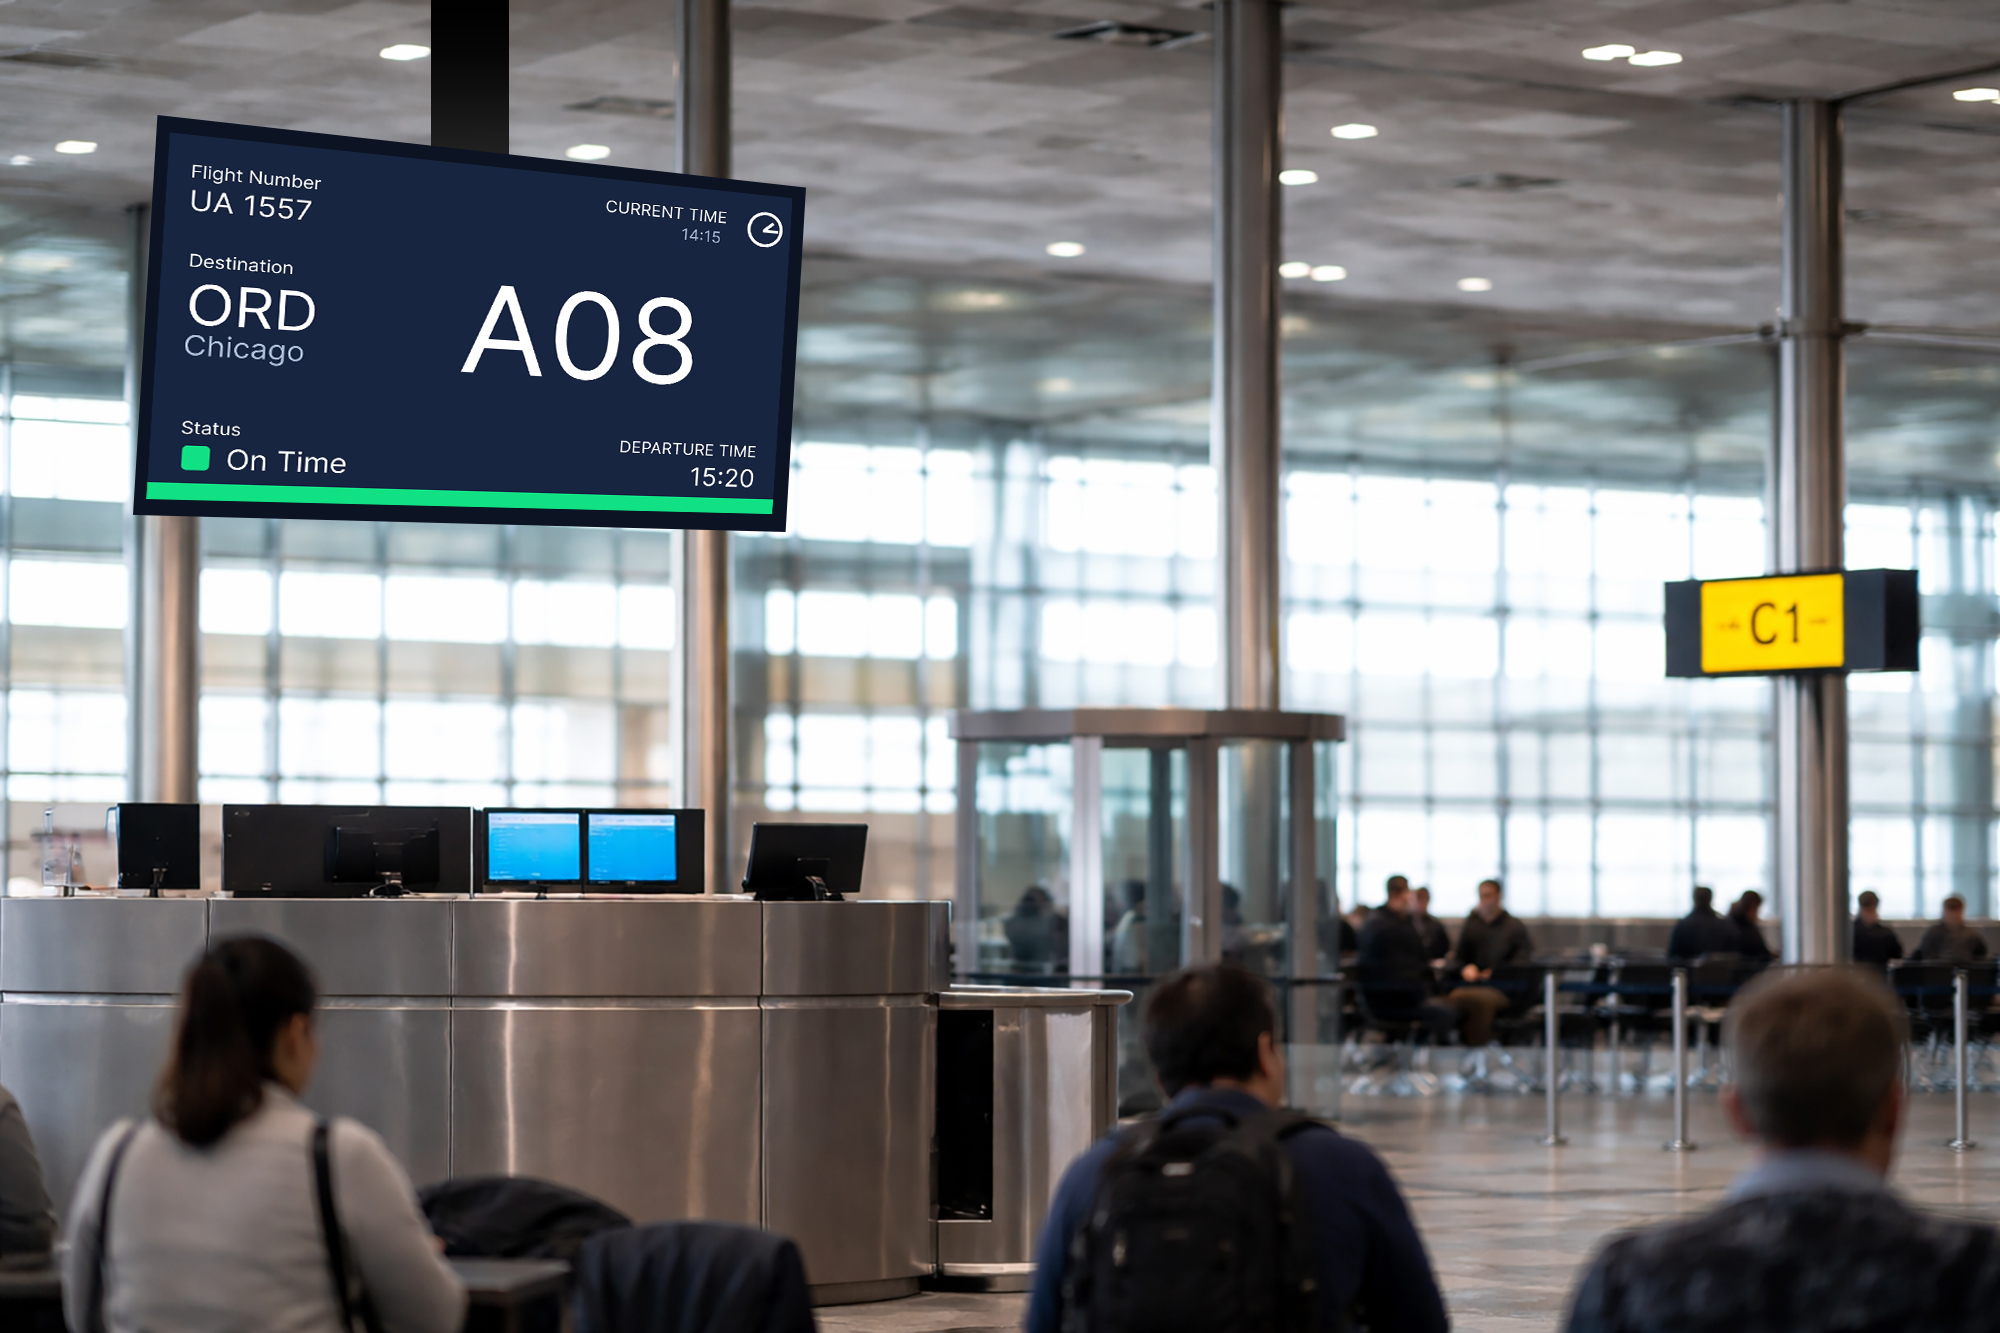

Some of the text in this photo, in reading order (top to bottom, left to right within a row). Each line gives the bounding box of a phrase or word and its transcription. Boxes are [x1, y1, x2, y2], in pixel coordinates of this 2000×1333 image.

[192, 165, 322, 190] Flight Number
[191, 190, 312, 221] UA 1557
[606, 200, 728, 224] CURRENT TIME
[681, 228, 721, 243] 14:15
[190, 253, 294, 275] Destination
[188, 284, 316, 331] ORD
[461, 285, 694, 386] A08
[184, 334, 304, 367] Chicago
[182, 420, 241, 436] Status
[226, 448, 347, 474] On Time
[619, 440, 757, 458] DEPARTURE TIME
[690, 467, 754, 488] 15:20
[1750, 602, 1800, 645] C1
